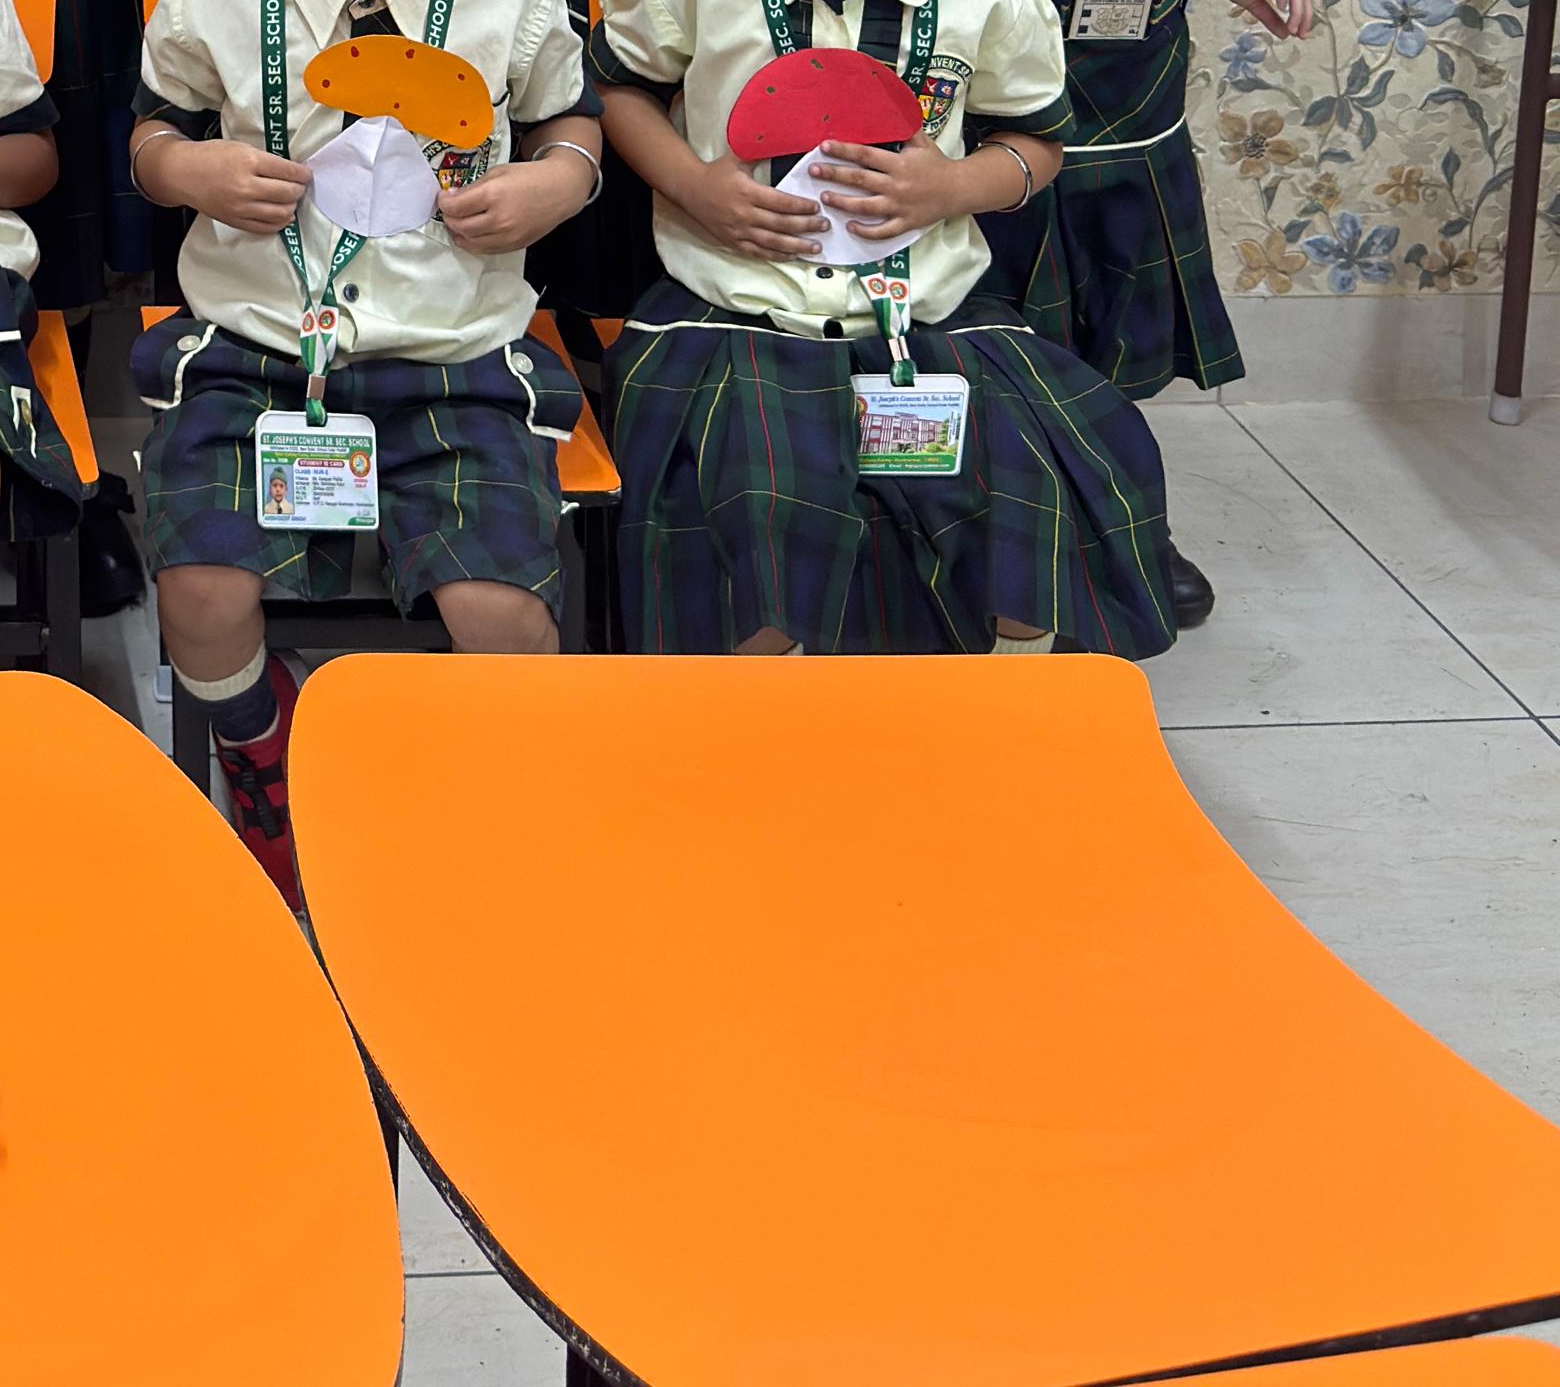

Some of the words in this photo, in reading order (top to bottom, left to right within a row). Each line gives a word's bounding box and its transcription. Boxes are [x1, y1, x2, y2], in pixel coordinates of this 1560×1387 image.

[776, 22, 797, 55] SEC.
[916, 24, 933, 58] SEC.
[267, 50, 282, 85] SEC.
[909, 62, 926, 84] SR.
[931, 57, 958, 71] NVENT
[269, 90, 283, 115] SR.
[272, 435, 298, 445] JOSEPH'S
[299, 436, 324, 446] CONVENT
[348, 438, 370, 448] SCHOOL
